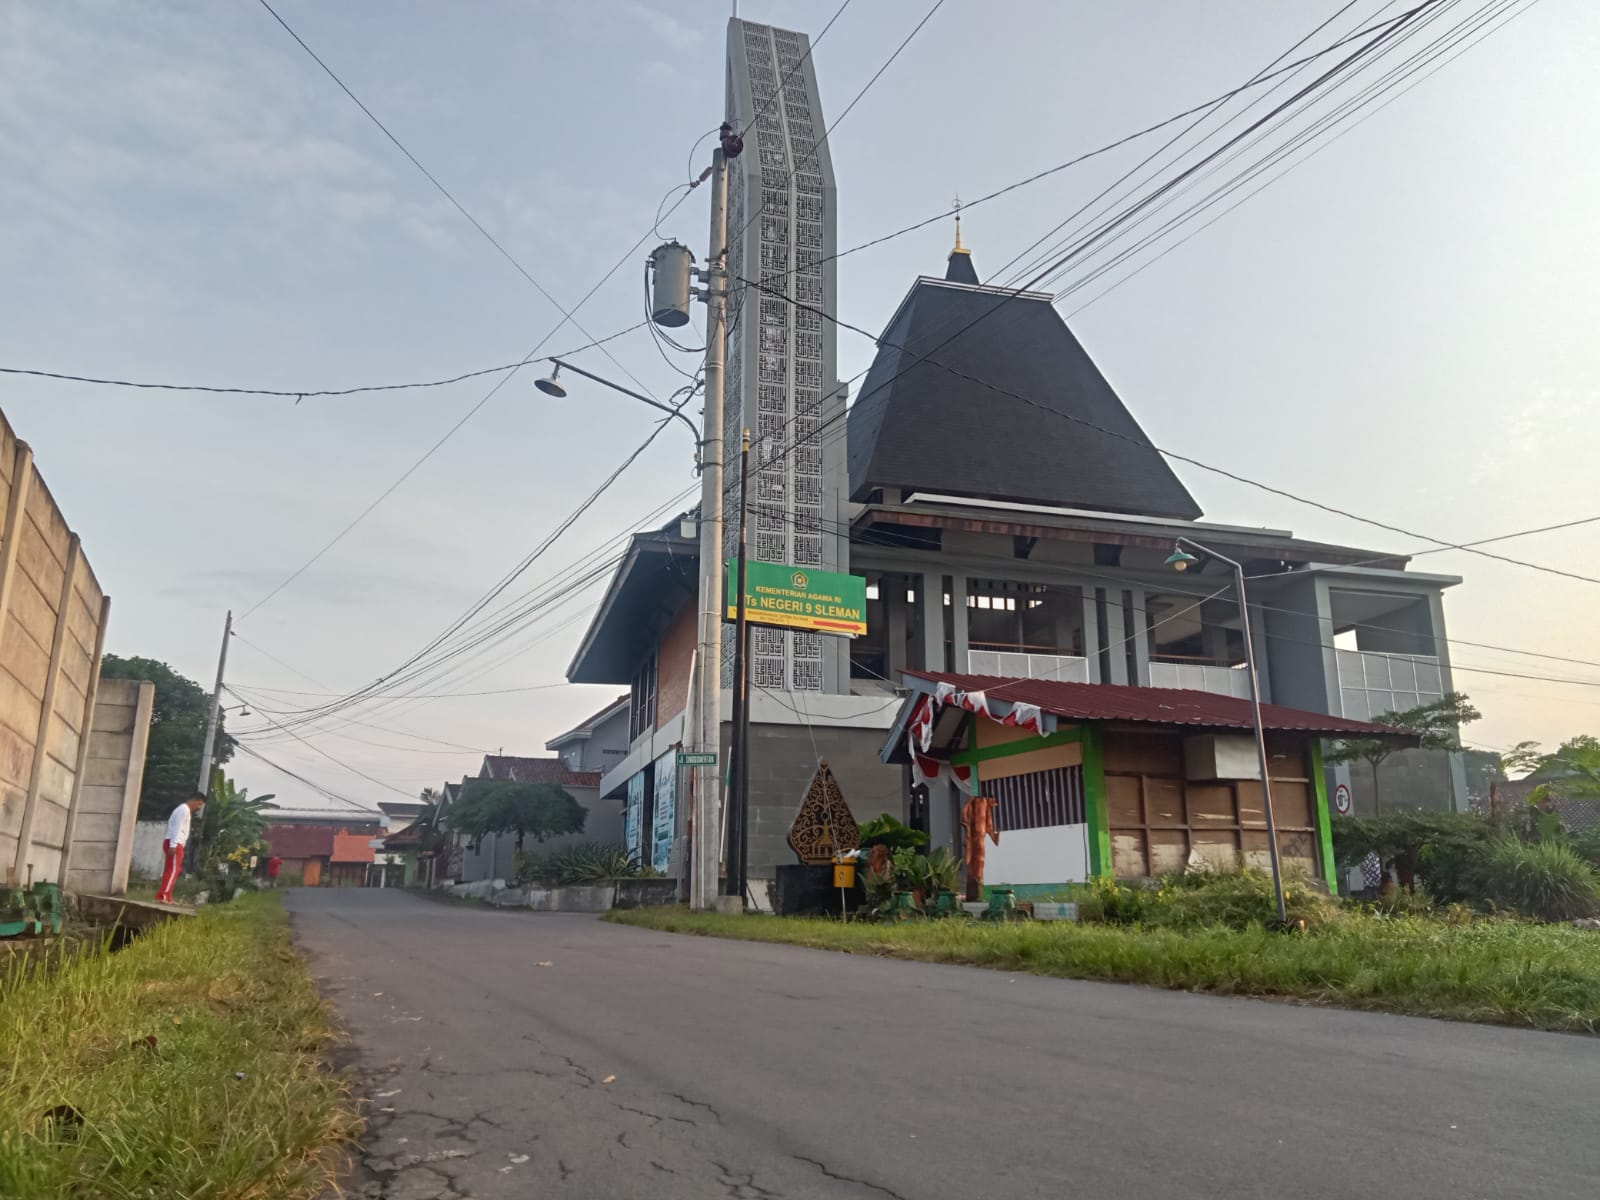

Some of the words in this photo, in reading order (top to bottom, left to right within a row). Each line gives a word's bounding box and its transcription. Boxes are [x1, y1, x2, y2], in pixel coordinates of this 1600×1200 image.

[756, 585, 807, 598] KEMENTERIAN
[808, 592, 833, 602] AGAMA
[760, 596, 803, 612] NEGERI
[805, 603, 812, 614] 9
[815, 604, 860, 619] SLEMAN
